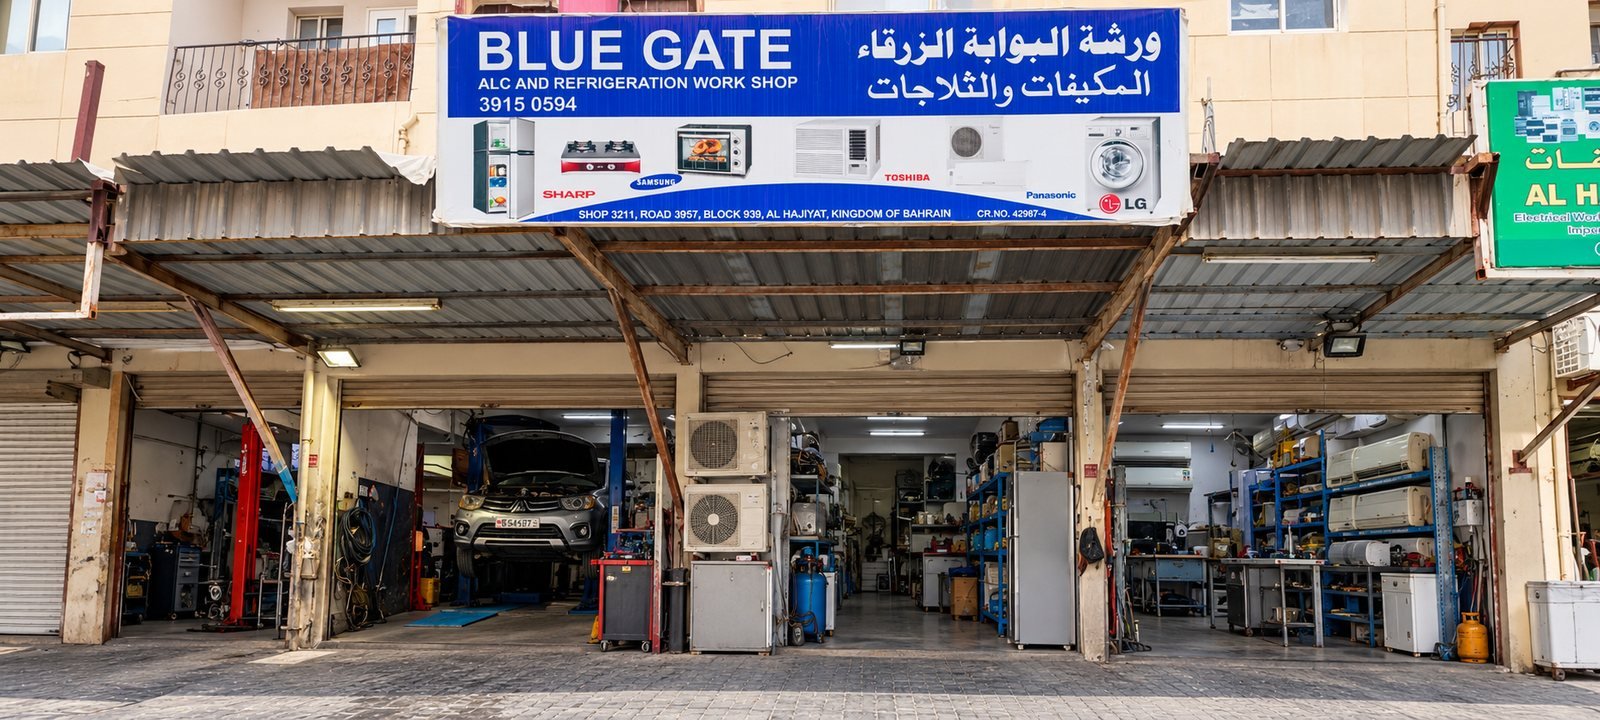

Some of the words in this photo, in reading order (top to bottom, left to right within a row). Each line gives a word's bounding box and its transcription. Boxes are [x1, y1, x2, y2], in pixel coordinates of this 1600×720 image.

[857, 28, 954, 65] الزرقاء
[963, 26, 1070, 64] البوابة
[1079, 23, 1162, 61] ورشة
[478, 30, 623, 71] BLUE
[643, 29, 792, 71] GATE
[515, 77, 549, 90] AND
[553, 77, 688, 90] REFRIGERATION
[692, 76, 746, 89] WORK
[751, 76, 798, 89] SHOP
[867, 70, 1014, 107] والثلاجات
[1021, 64, 1151, 104] المكيفات
[479, 96, 526, 112] 3915
[531, 96, 577, 112] 0594
[636, 178, 675, 186] SAMSUNG
[885, 174, 930, 182] TOSHIBA
[542, 190, 596, 199] SHARP
[1026, 191, 1077, 200] Panasonic
[1525, 183, 1567, 206] AL
[1575, 183, 1600, 206] H
[1124, 197, 1147, 210] LG
[578, 209, 609, 219] SHOP
[611, 209, 638, 220] 3211,
[640, 209, 671, 219] ROAD
[674, 209, 701, 220] 3957,
[703, 209, 741, 219] BLOCK
[743, 209, 764, 220] 939,
[766, 209, 780, 218] AL
[783, 209, 829, 220] HAJIYAT,
[831, 209, 882, 218] KINGDOM
[885, 209, 900, 218] OF
[903, 209, 951, 218] BAHRAIN
[976, 209, 1010, 218] CR.NO.
[1012, 209, 1047, 218] 42987-4
[1514, 212, 1571, 223] Electrical
